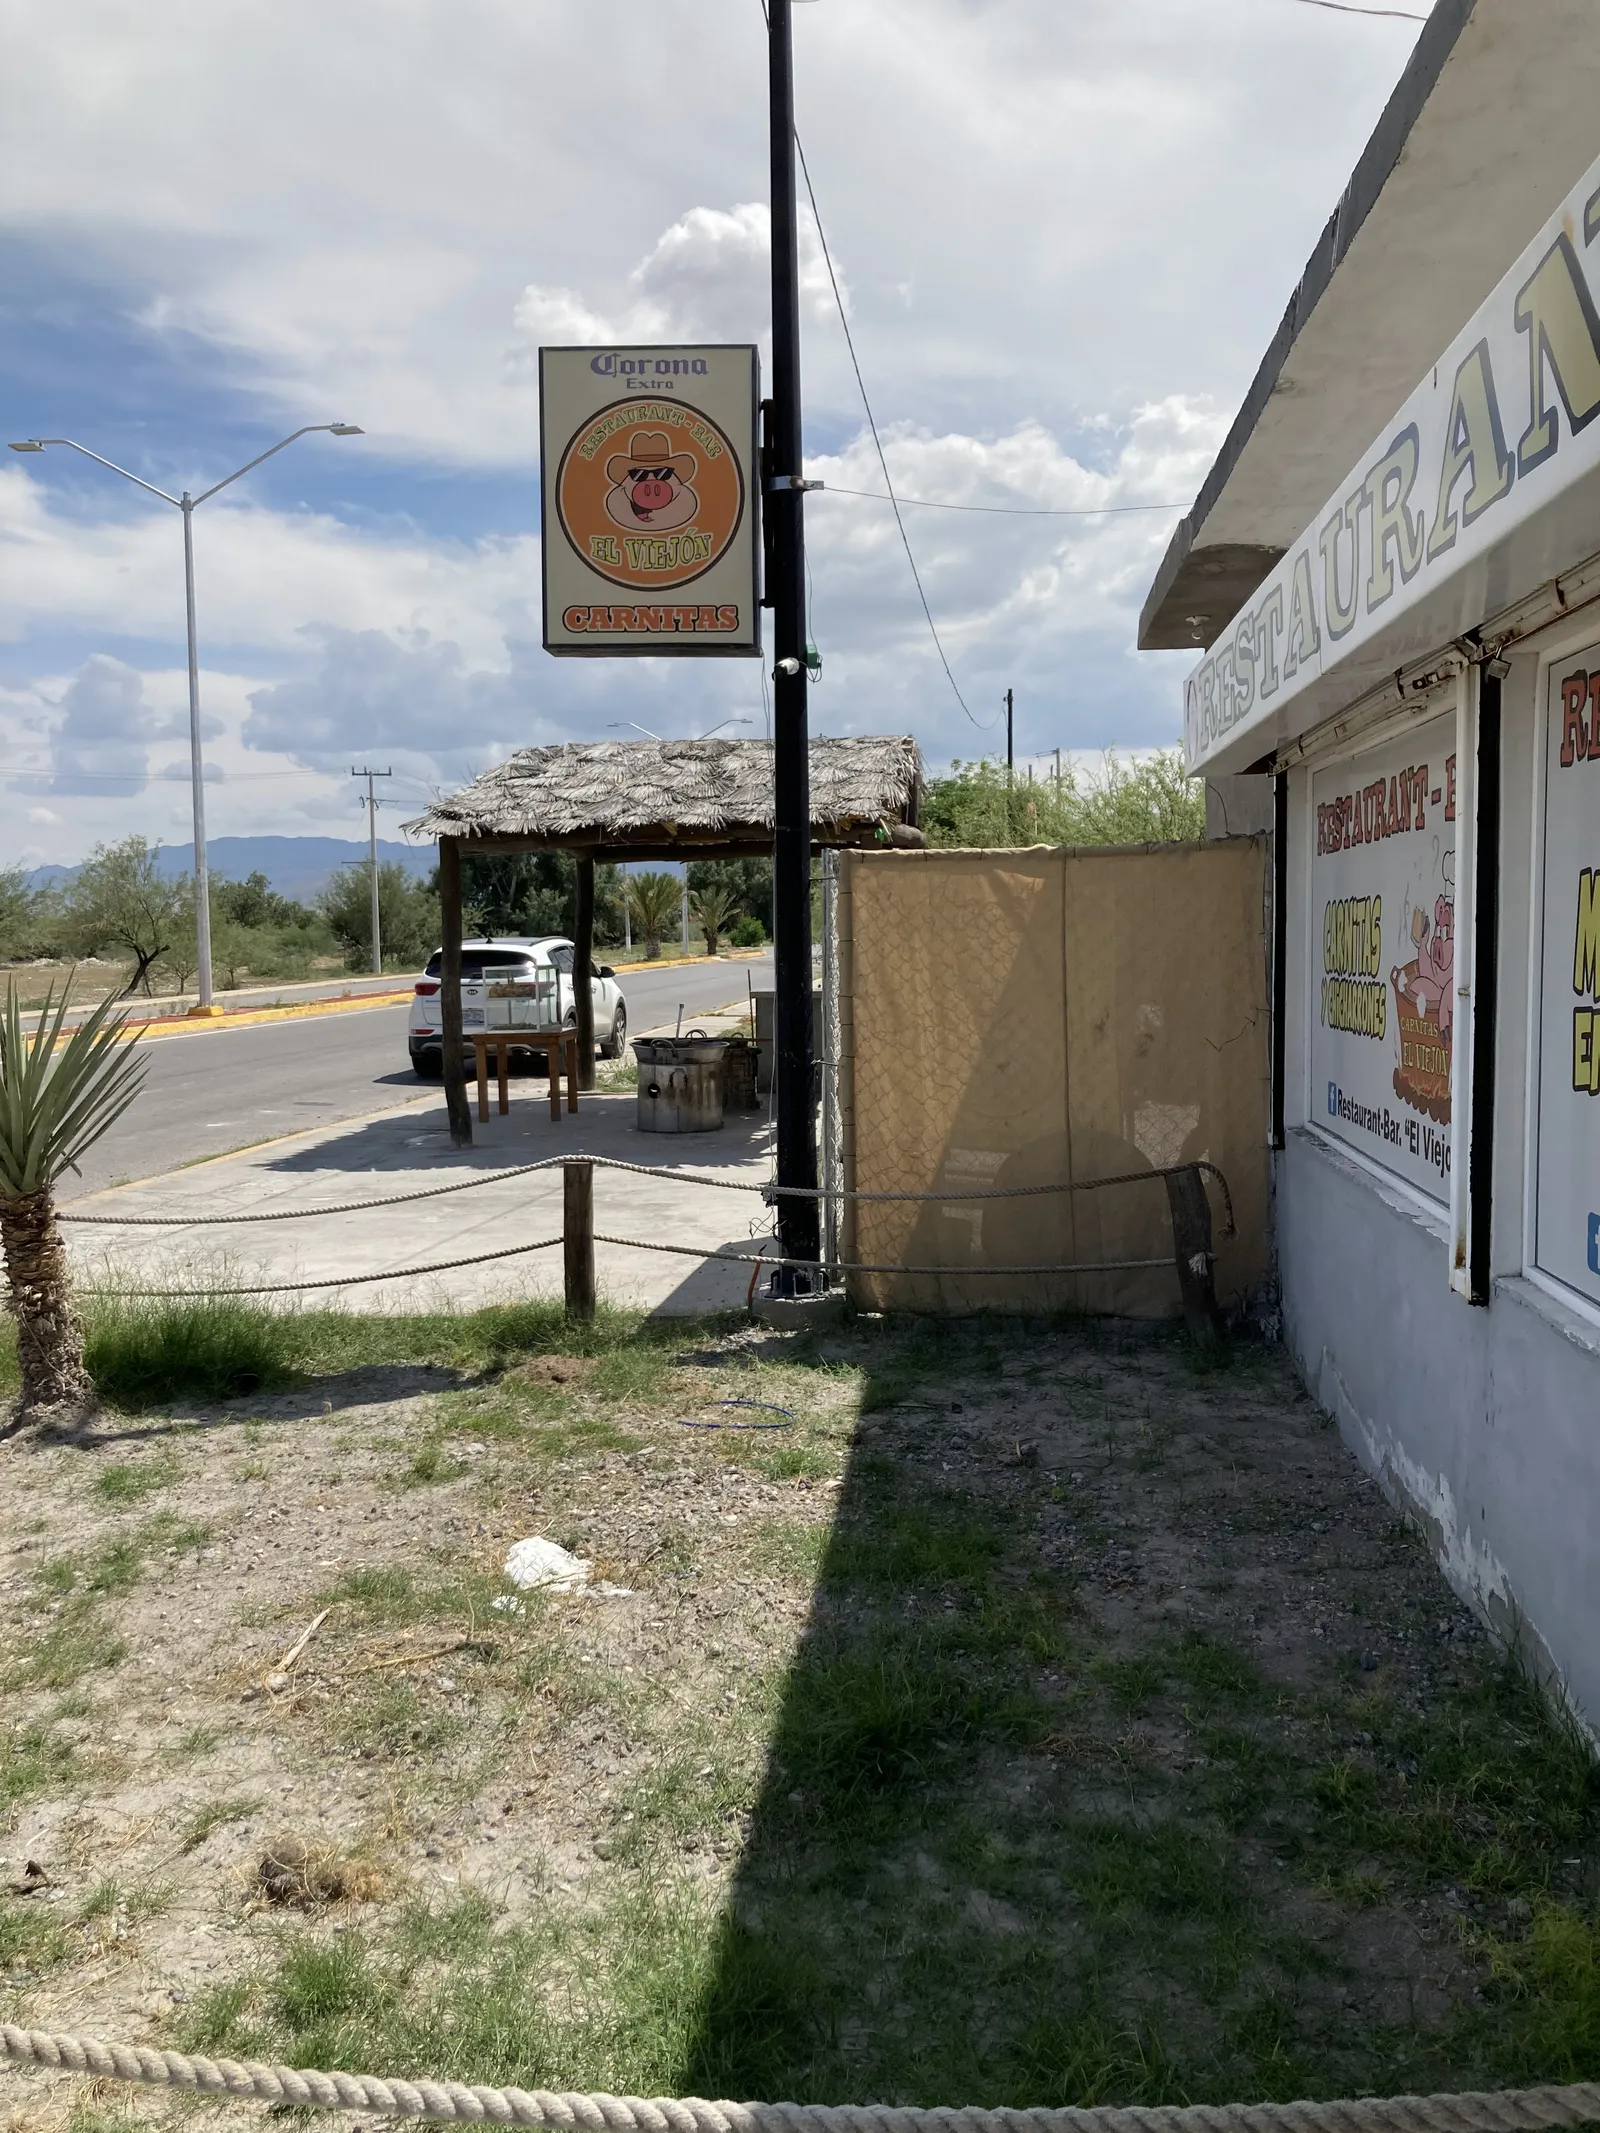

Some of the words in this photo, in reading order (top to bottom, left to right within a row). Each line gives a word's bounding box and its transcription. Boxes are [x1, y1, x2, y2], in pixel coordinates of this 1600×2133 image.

[590, 353, 709, 378] Corona
[626, 378, 674, 389] Extra
[590, 536, 621, 565] EL
[625, 528, 712, 570] VIEJÓN
[563, 605, 739, 633] CARNITAS
[1323, 894, 1381, 979] CARNITAS
[1400, 1016, 1439, 1038] CARNITAS
[1403, 1041, 1414, 1069] EL
